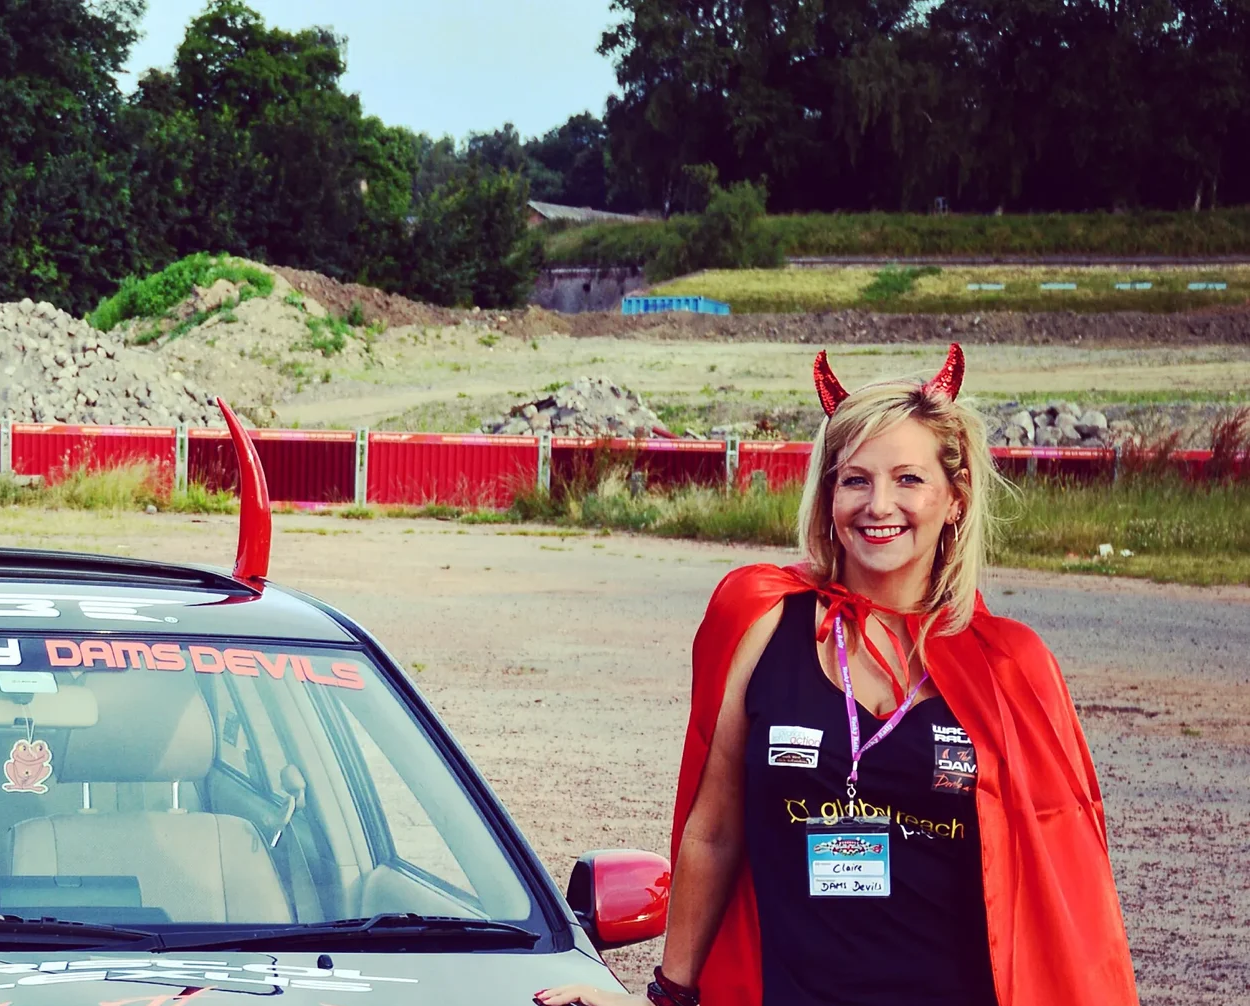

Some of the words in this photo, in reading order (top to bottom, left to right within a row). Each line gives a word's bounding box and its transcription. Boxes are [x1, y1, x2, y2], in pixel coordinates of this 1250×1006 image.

[44, 640, 187, 671] DAMS
[189, 645, 366, 690] DEVILS
[932, 724, 968, 735] WAC
[833, 863, 863, 873] Claire
[852, 880, 882, 892] Devils
